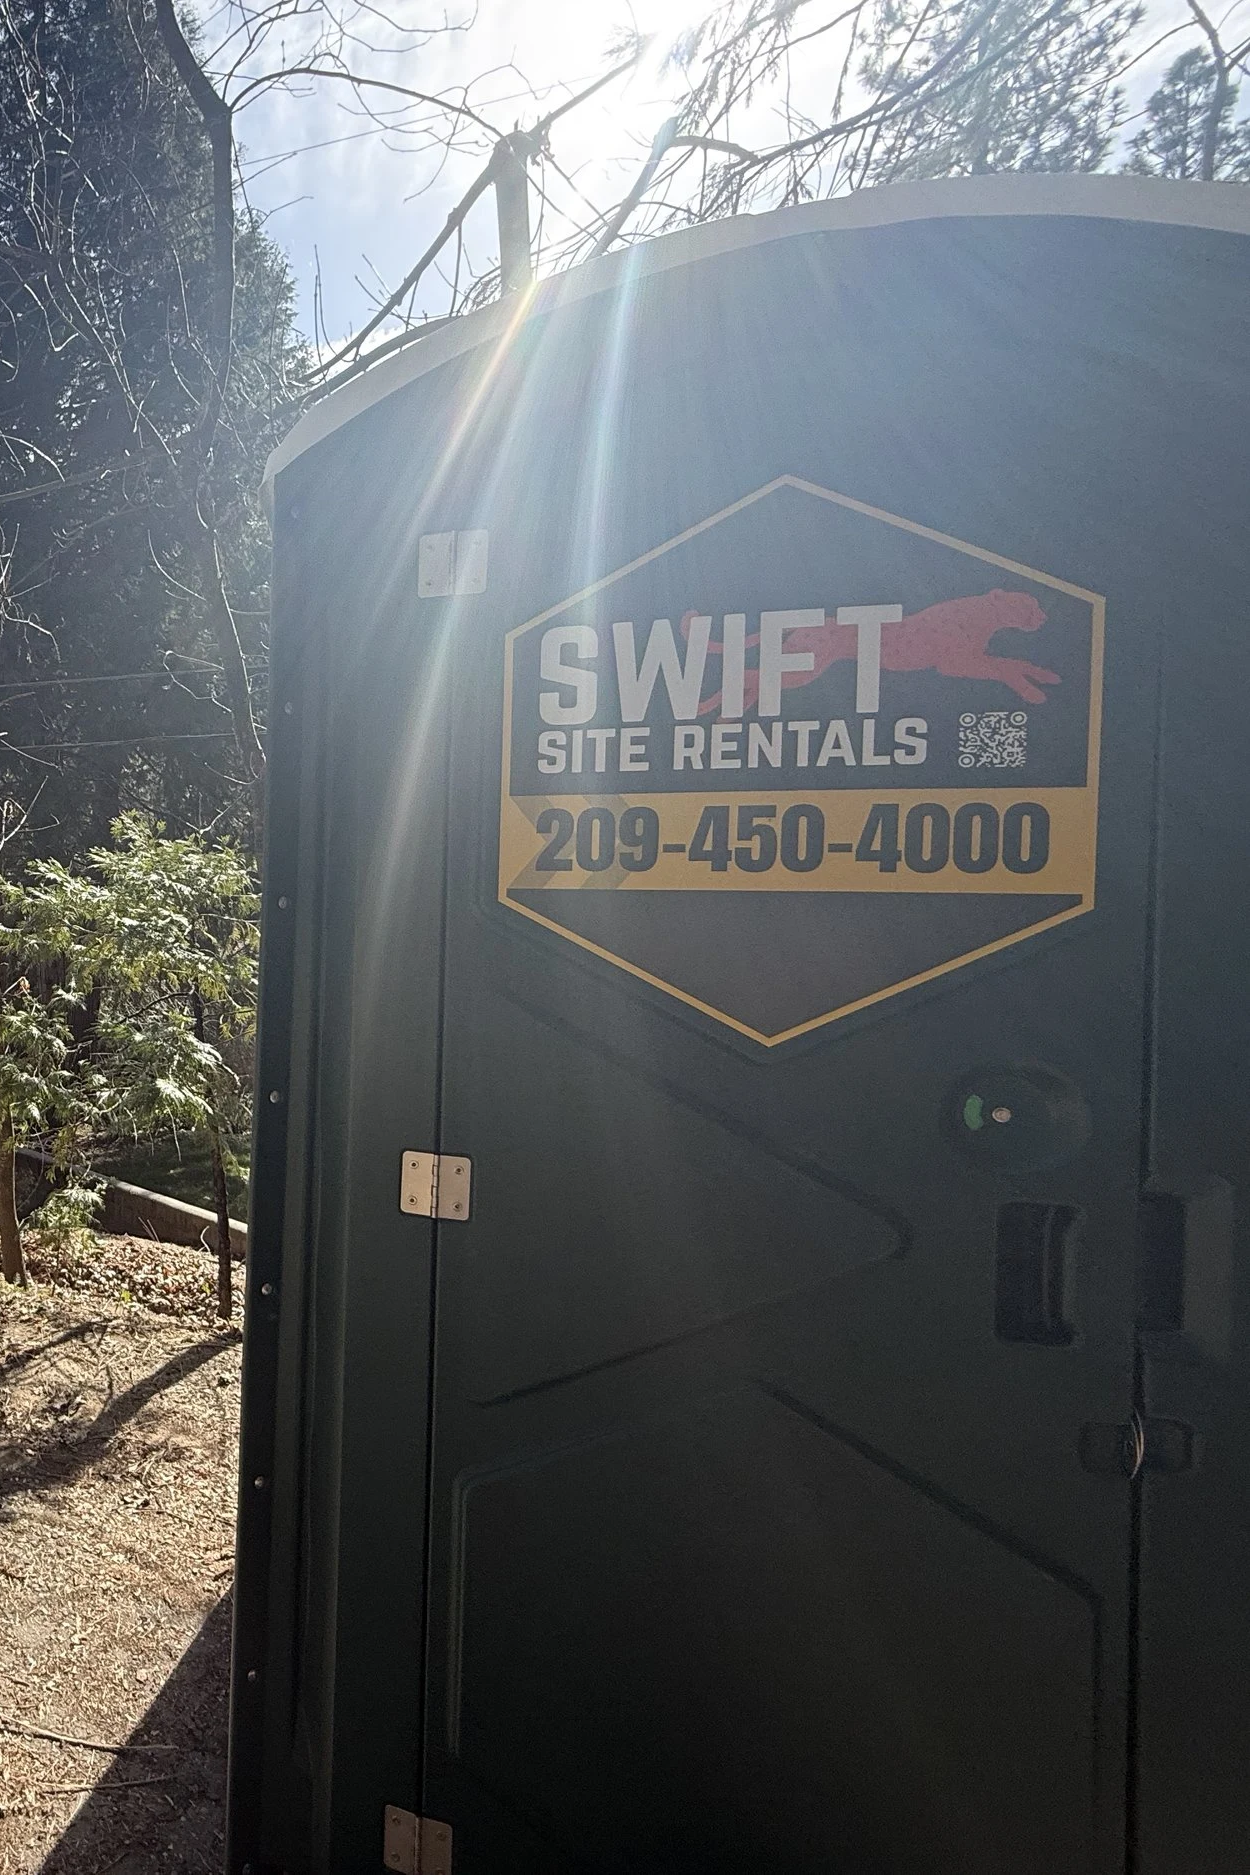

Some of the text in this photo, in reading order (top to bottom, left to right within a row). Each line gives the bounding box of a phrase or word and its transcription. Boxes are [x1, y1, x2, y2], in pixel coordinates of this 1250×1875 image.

[538, 603, 903, 725] SWIFT
[537, 716, 928, 774] SITE RENTALS
[535, 801, 1050, 874] 209-450-4000
